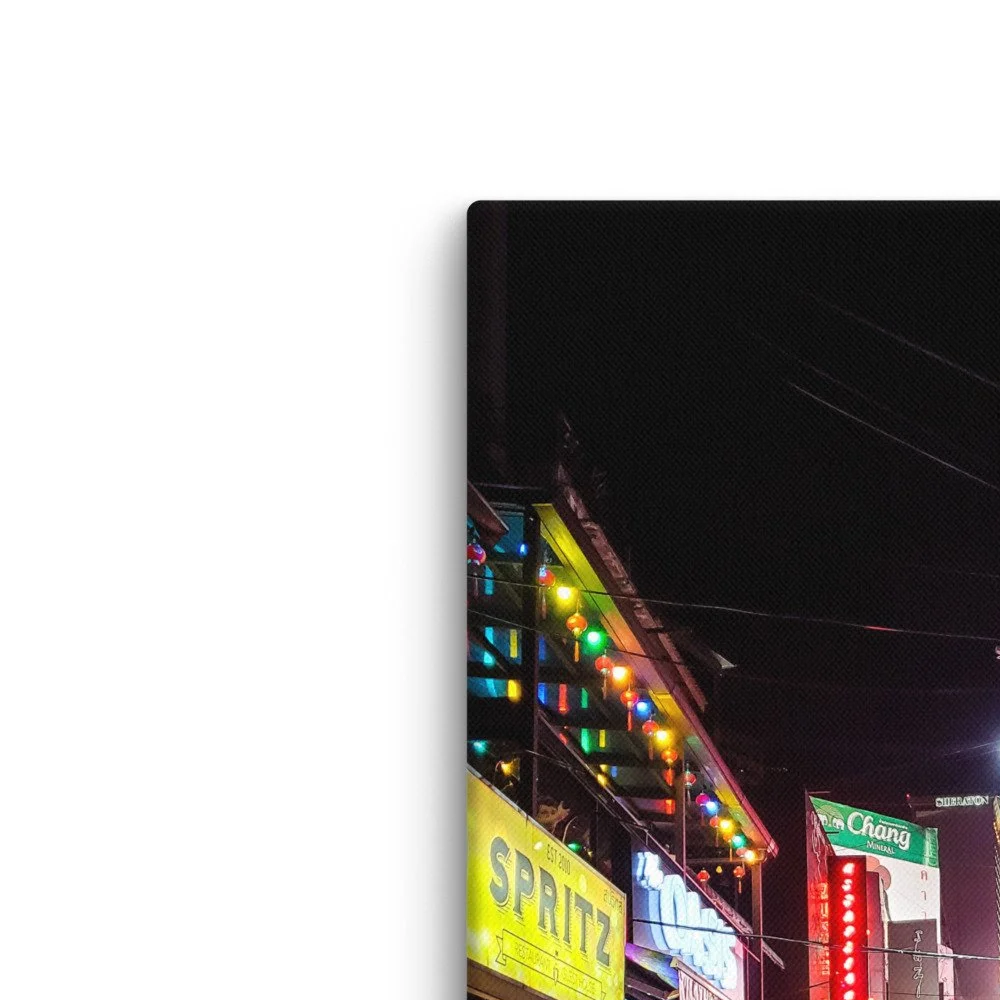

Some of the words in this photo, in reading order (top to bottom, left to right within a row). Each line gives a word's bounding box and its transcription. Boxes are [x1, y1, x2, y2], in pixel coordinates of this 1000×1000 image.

[935, 795, 989, 807] SHERATON
[847, 811, 911, 851] Chang
[866, 840, 896, 854] MINERAL
[489, 836, 611, 967] SPRITZ
